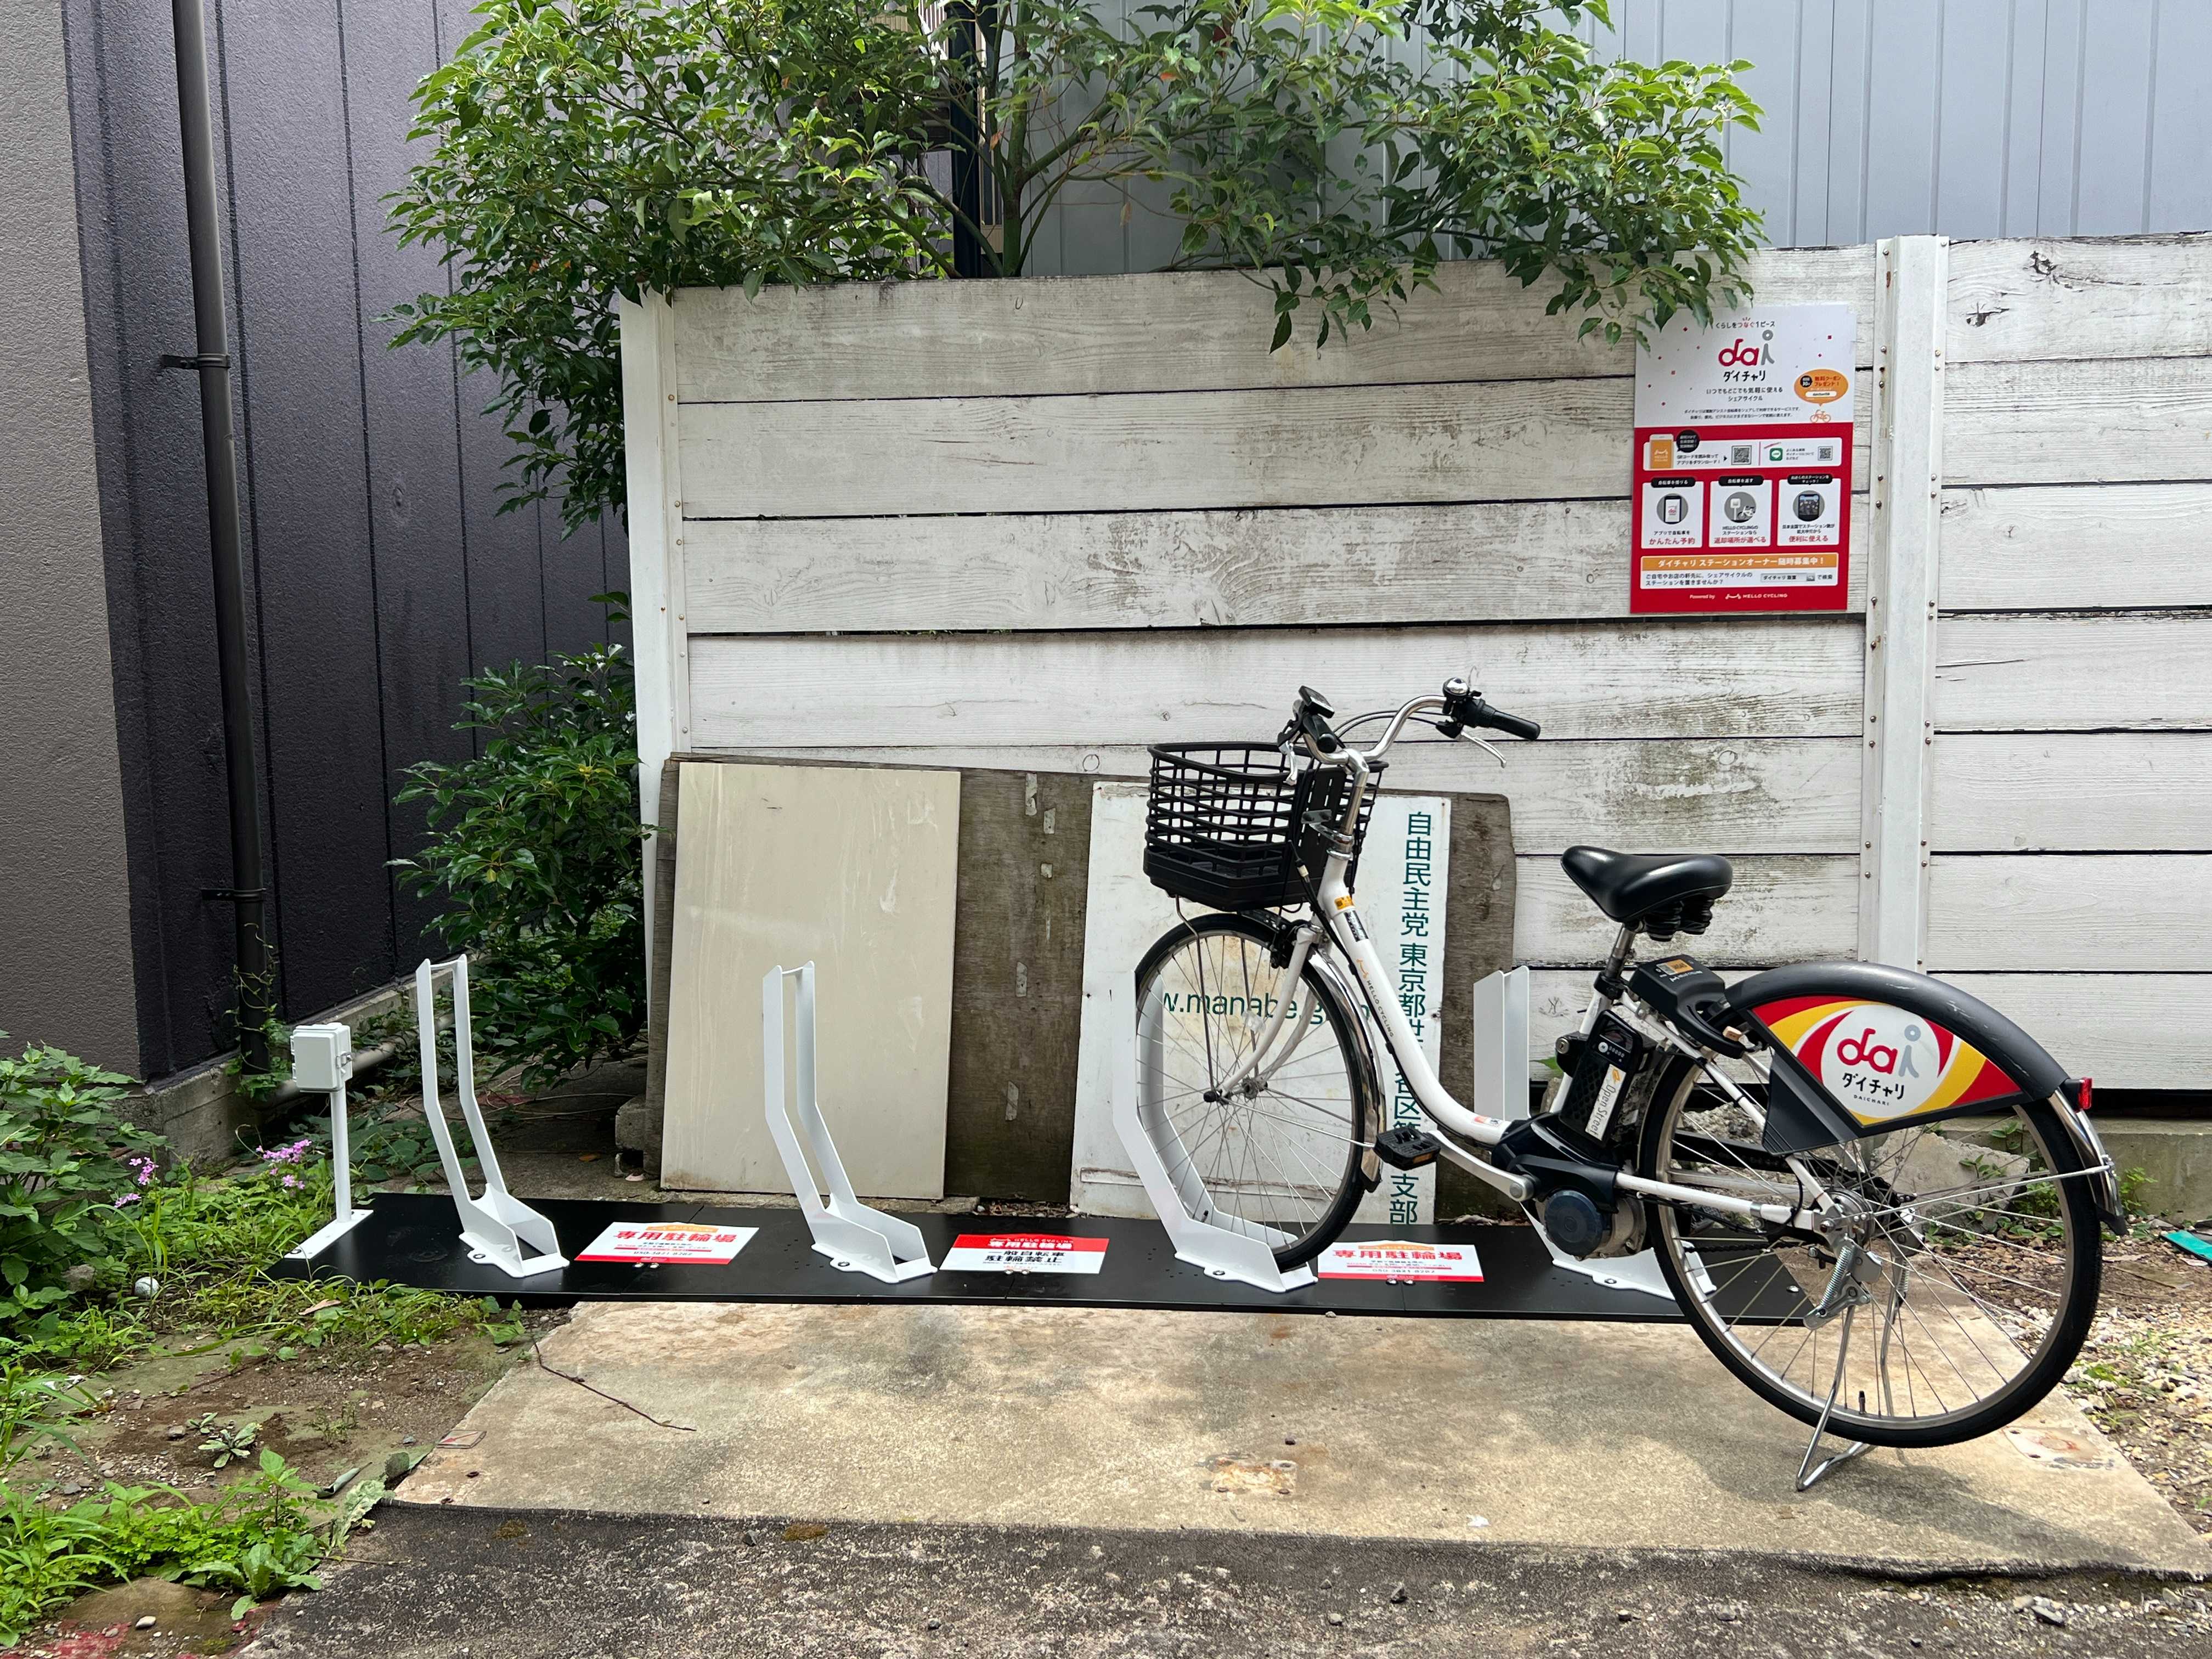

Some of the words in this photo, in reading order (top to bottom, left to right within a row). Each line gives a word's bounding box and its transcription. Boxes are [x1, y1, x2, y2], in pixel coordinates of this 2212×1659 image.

[1718, 330, 1775, 367] dai
[1723, 370, 1767, 382] ダイチャリ
[1706, 386, 1783, 394] いつでもどこでも気軽に使える
[1649, 537, 1695, 545] かんたん予約
[1658, 559, 1697, 568] ダイチャリ
[1400, 811, 1432, 937] 自由民主党
[1366, 980, 1380, 1005] HELLO
[1378, 1006, 1394, 1037] CYCLING
[1837, 1024, 1922, 1079] dai
[1842, 1071, 1905, 1100] ダイチャリ
[1853, 1094, 1890, 1106] DAICHARI
[613, 1231, 737, 1243] 専用駐輪場
[988, 1240, 1073, 1249] 専用駐輪場
[1333, 1250, 1463, 1260] 専用駐輪場
